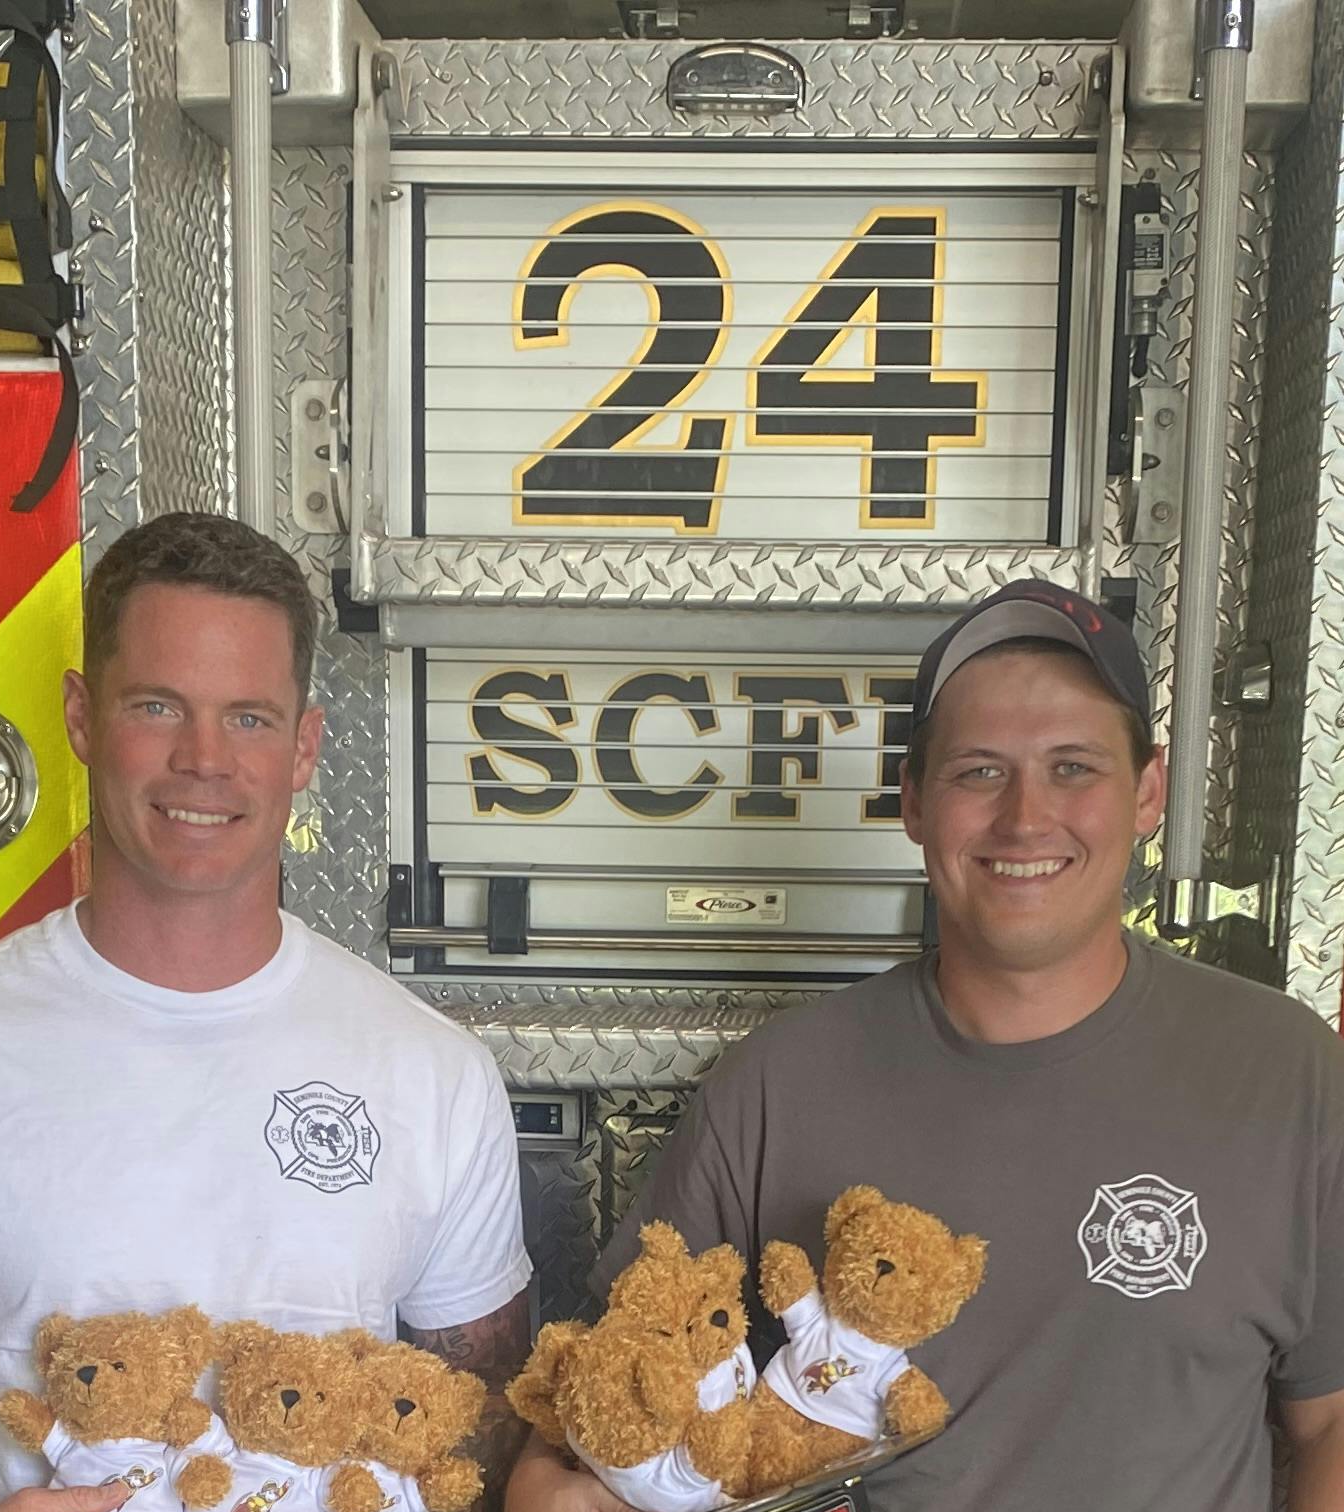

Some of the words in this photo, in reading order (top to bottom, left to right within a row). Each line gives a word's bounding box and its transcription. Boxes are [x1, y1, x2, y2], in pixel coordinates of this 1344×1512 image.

[512, 199, 988, 535] 24
[709, 899, 743, 911] Pierce
[324, 1093, 349, 1107] COUNTY
[316, 1170, 355, 1182] DEPARTMENT
